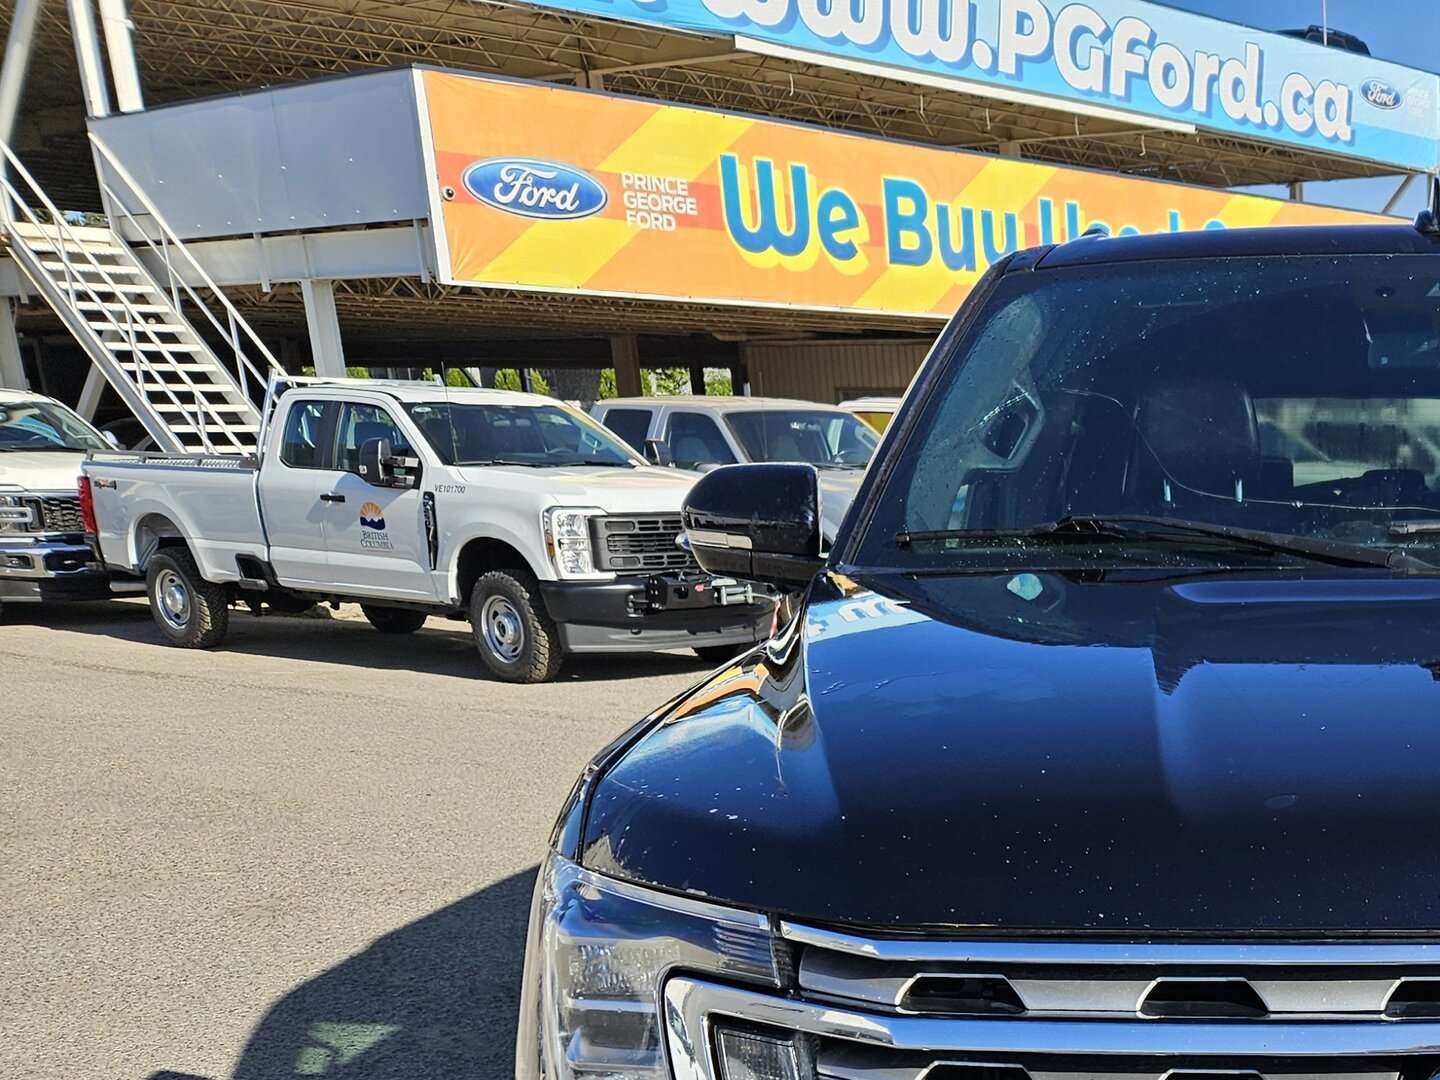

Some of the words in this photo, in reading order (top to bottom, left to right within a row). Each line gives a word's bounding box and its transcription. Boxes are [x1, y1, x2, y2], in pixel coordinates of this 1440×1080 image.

[494, 164, 580, 212] Ford
[621, 172, 689, 196] PRINCE
[623, 191, 699, 216] GEORGE
[719, 154, 860, 261] We
[882, 177, 1018, 273] Buy
[626, 210, 677, 232] FORD
